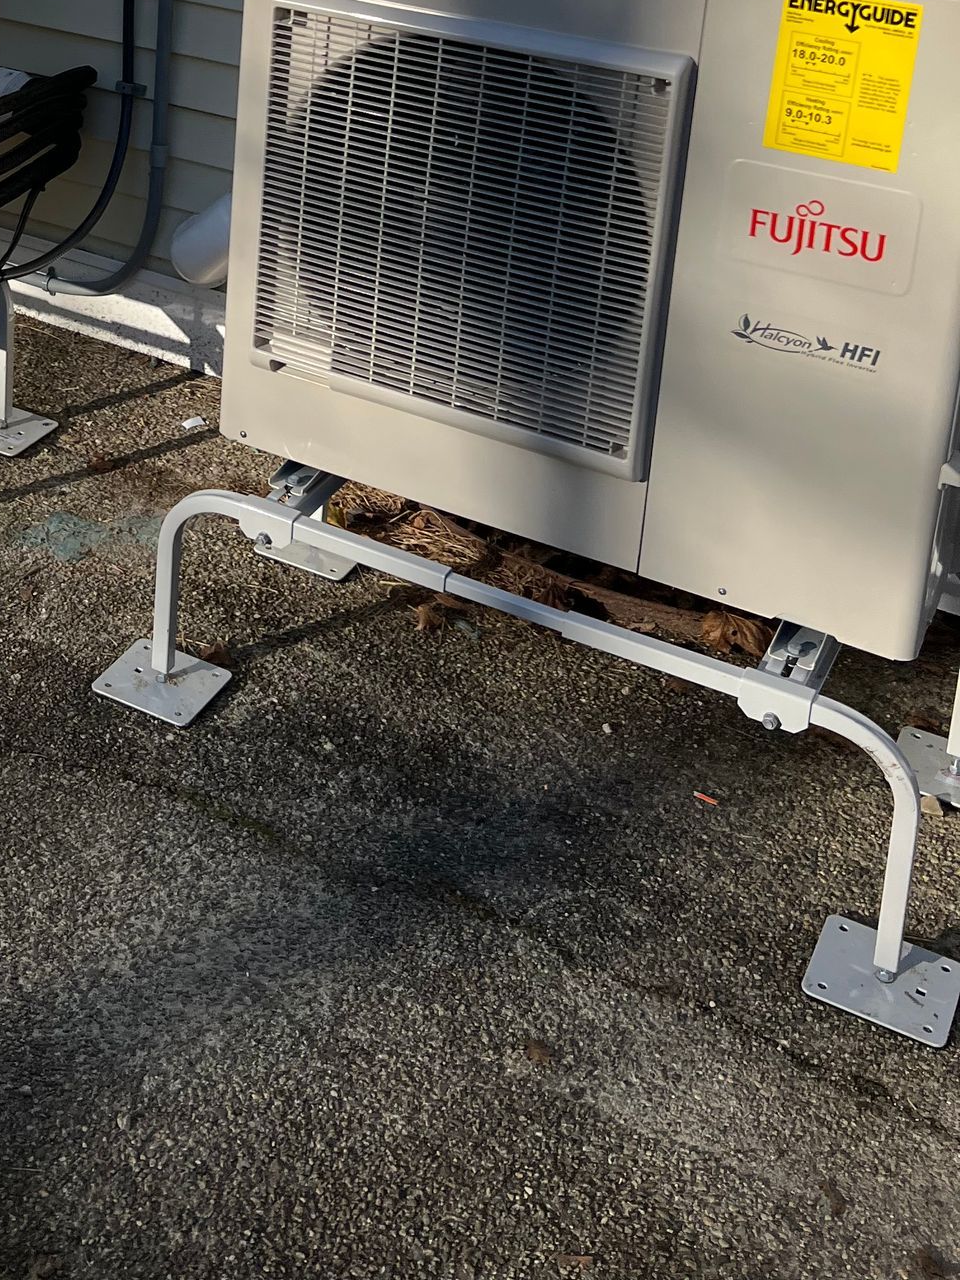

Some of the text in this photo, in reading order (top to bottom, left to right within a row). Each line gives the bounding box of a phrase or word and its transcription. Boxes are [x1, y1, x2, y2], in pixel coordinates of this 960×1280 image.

[792, 48, 847, 67] 18.0-20.0
[785, 107, 833, 125] 9.0-10.3
[747, 206, 887, 262] FUJITSU
[749, 320, 881, 367] Halcyon HFI
